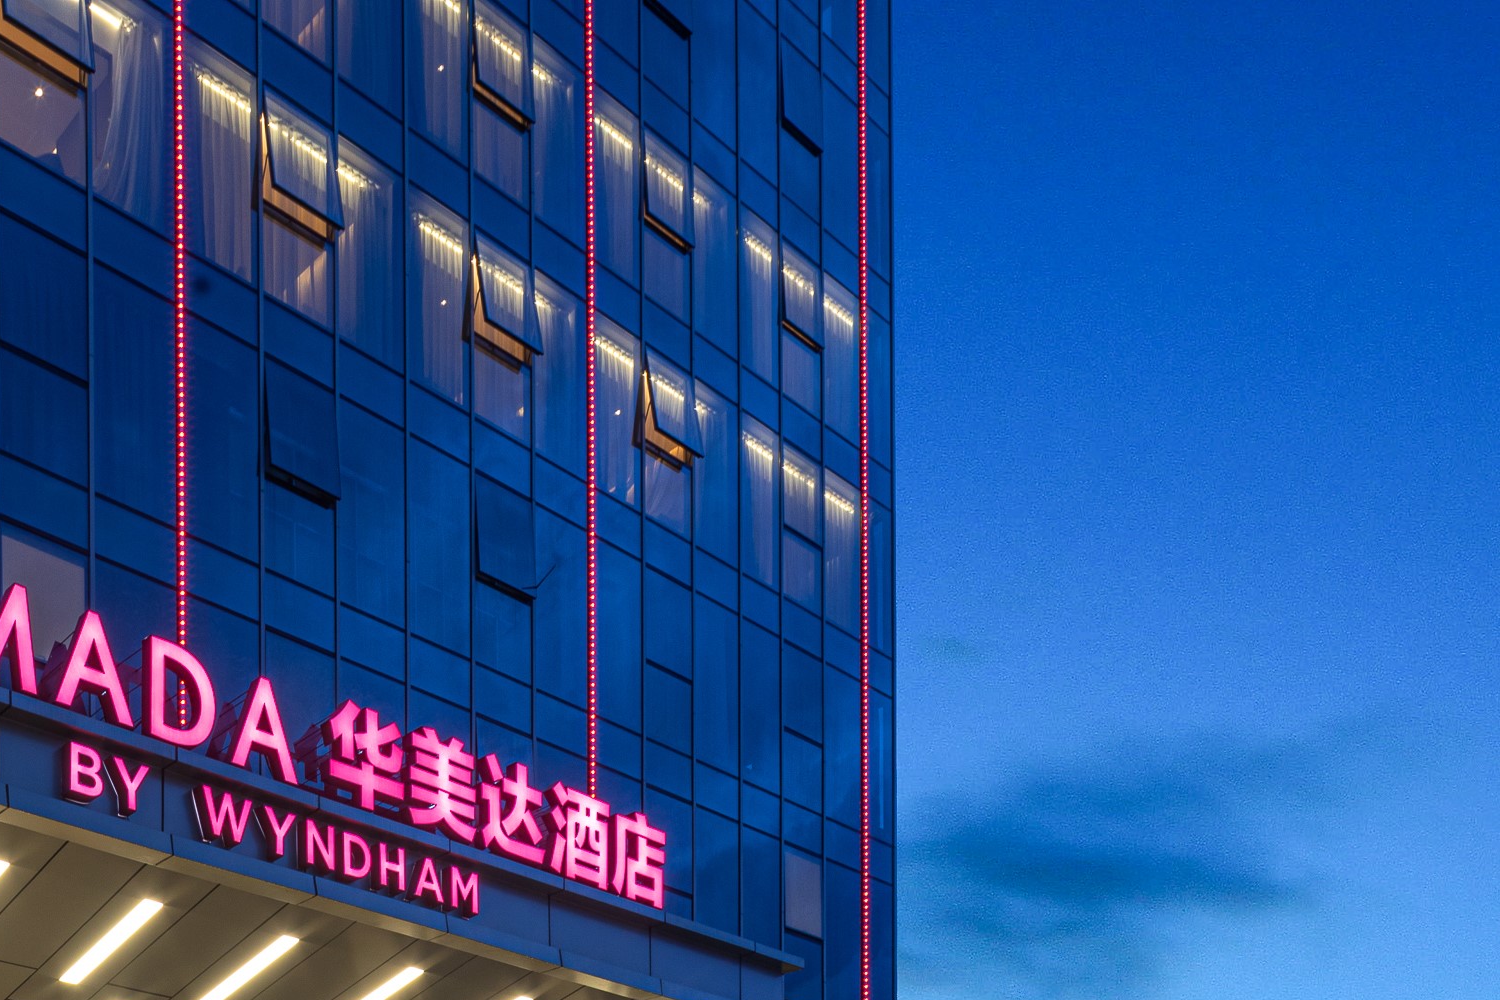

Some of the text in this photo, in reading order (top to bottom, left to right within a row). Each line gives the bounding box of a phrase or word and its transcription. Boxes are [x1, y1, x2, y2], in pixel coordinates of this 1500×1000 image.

[65, 742, 480, 916] BY WYNDHAM
[326, 699, 667, 910] 华美达酒店
